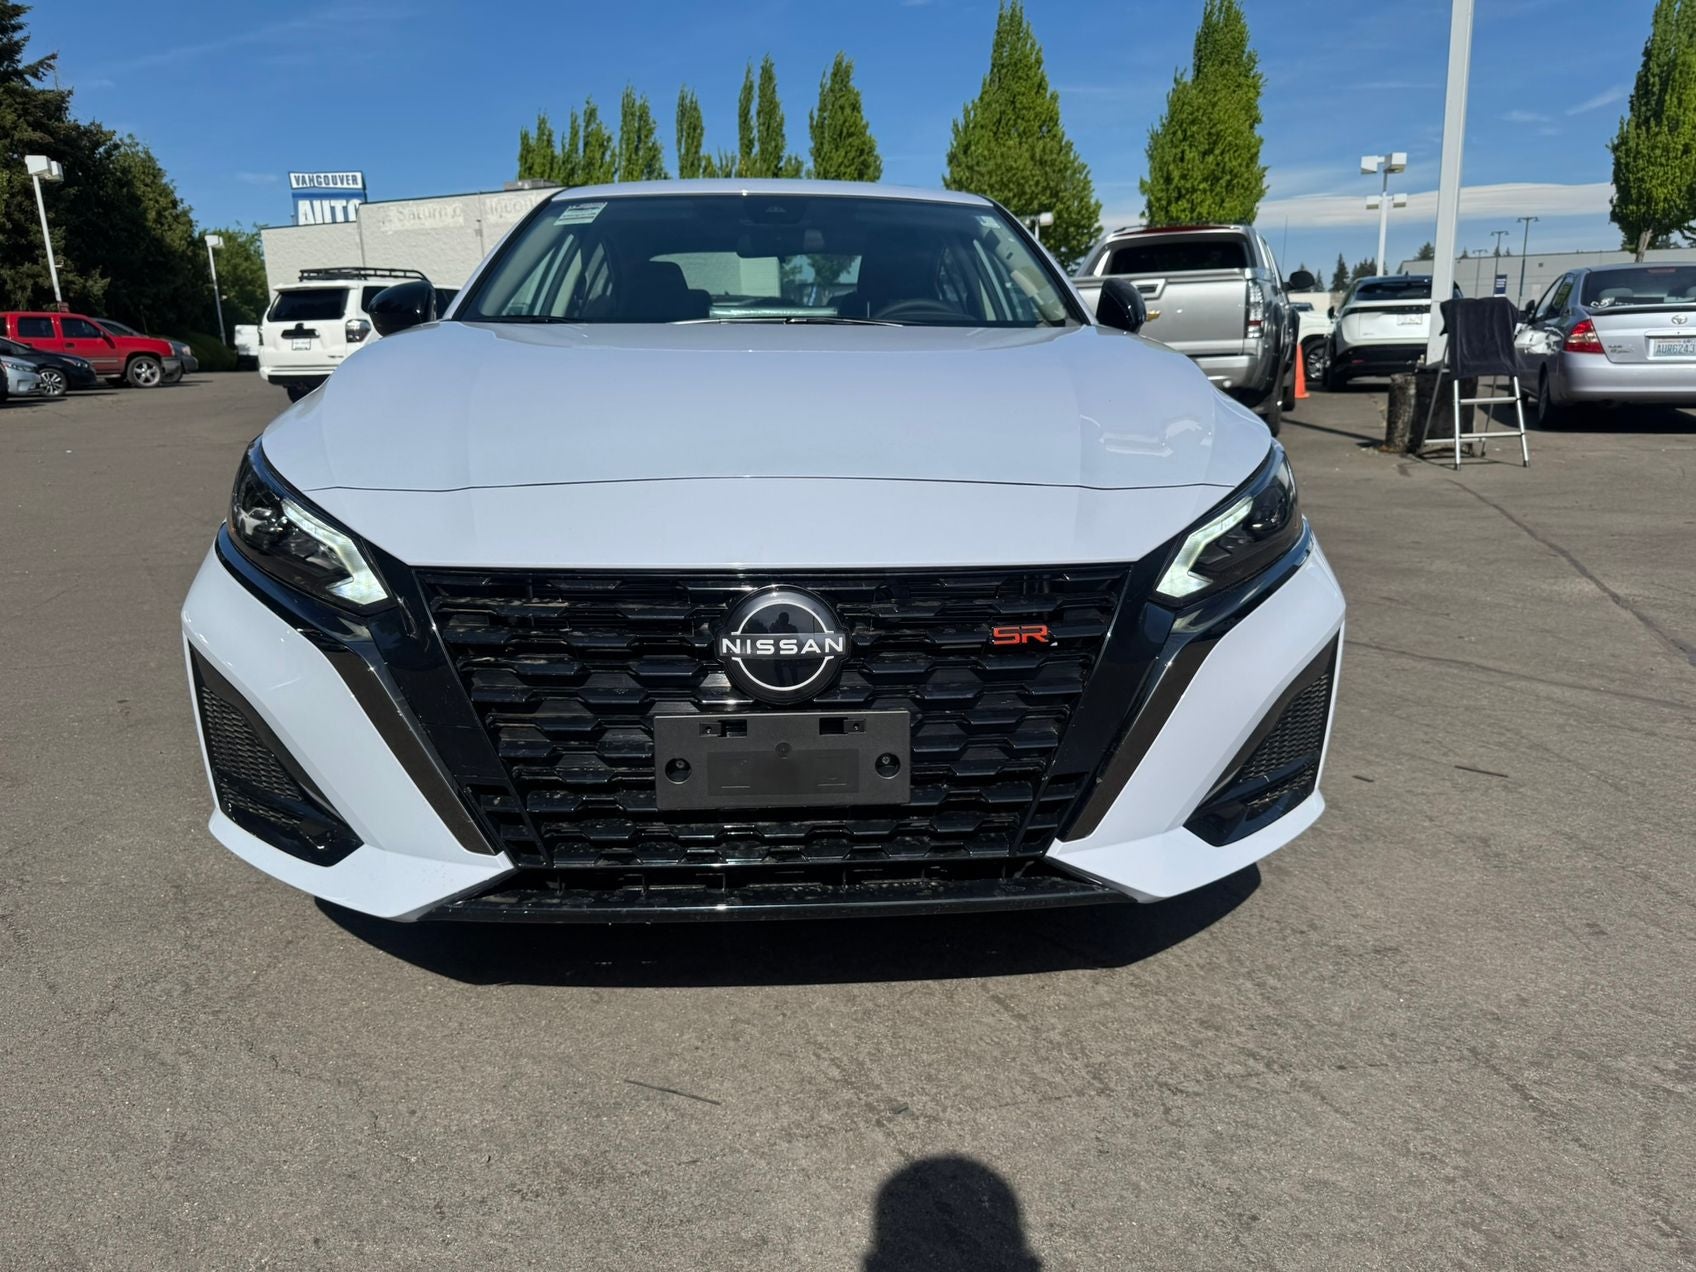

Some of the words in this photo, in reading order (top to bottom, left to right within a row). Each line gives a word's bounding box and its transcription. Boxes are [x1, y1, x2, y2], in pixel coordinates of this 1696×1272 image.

[294, 174, 359, 186] VANCOUVER
[993, 625, 1049, 645] SR
[721, 636, 844, 655] NISSAN
